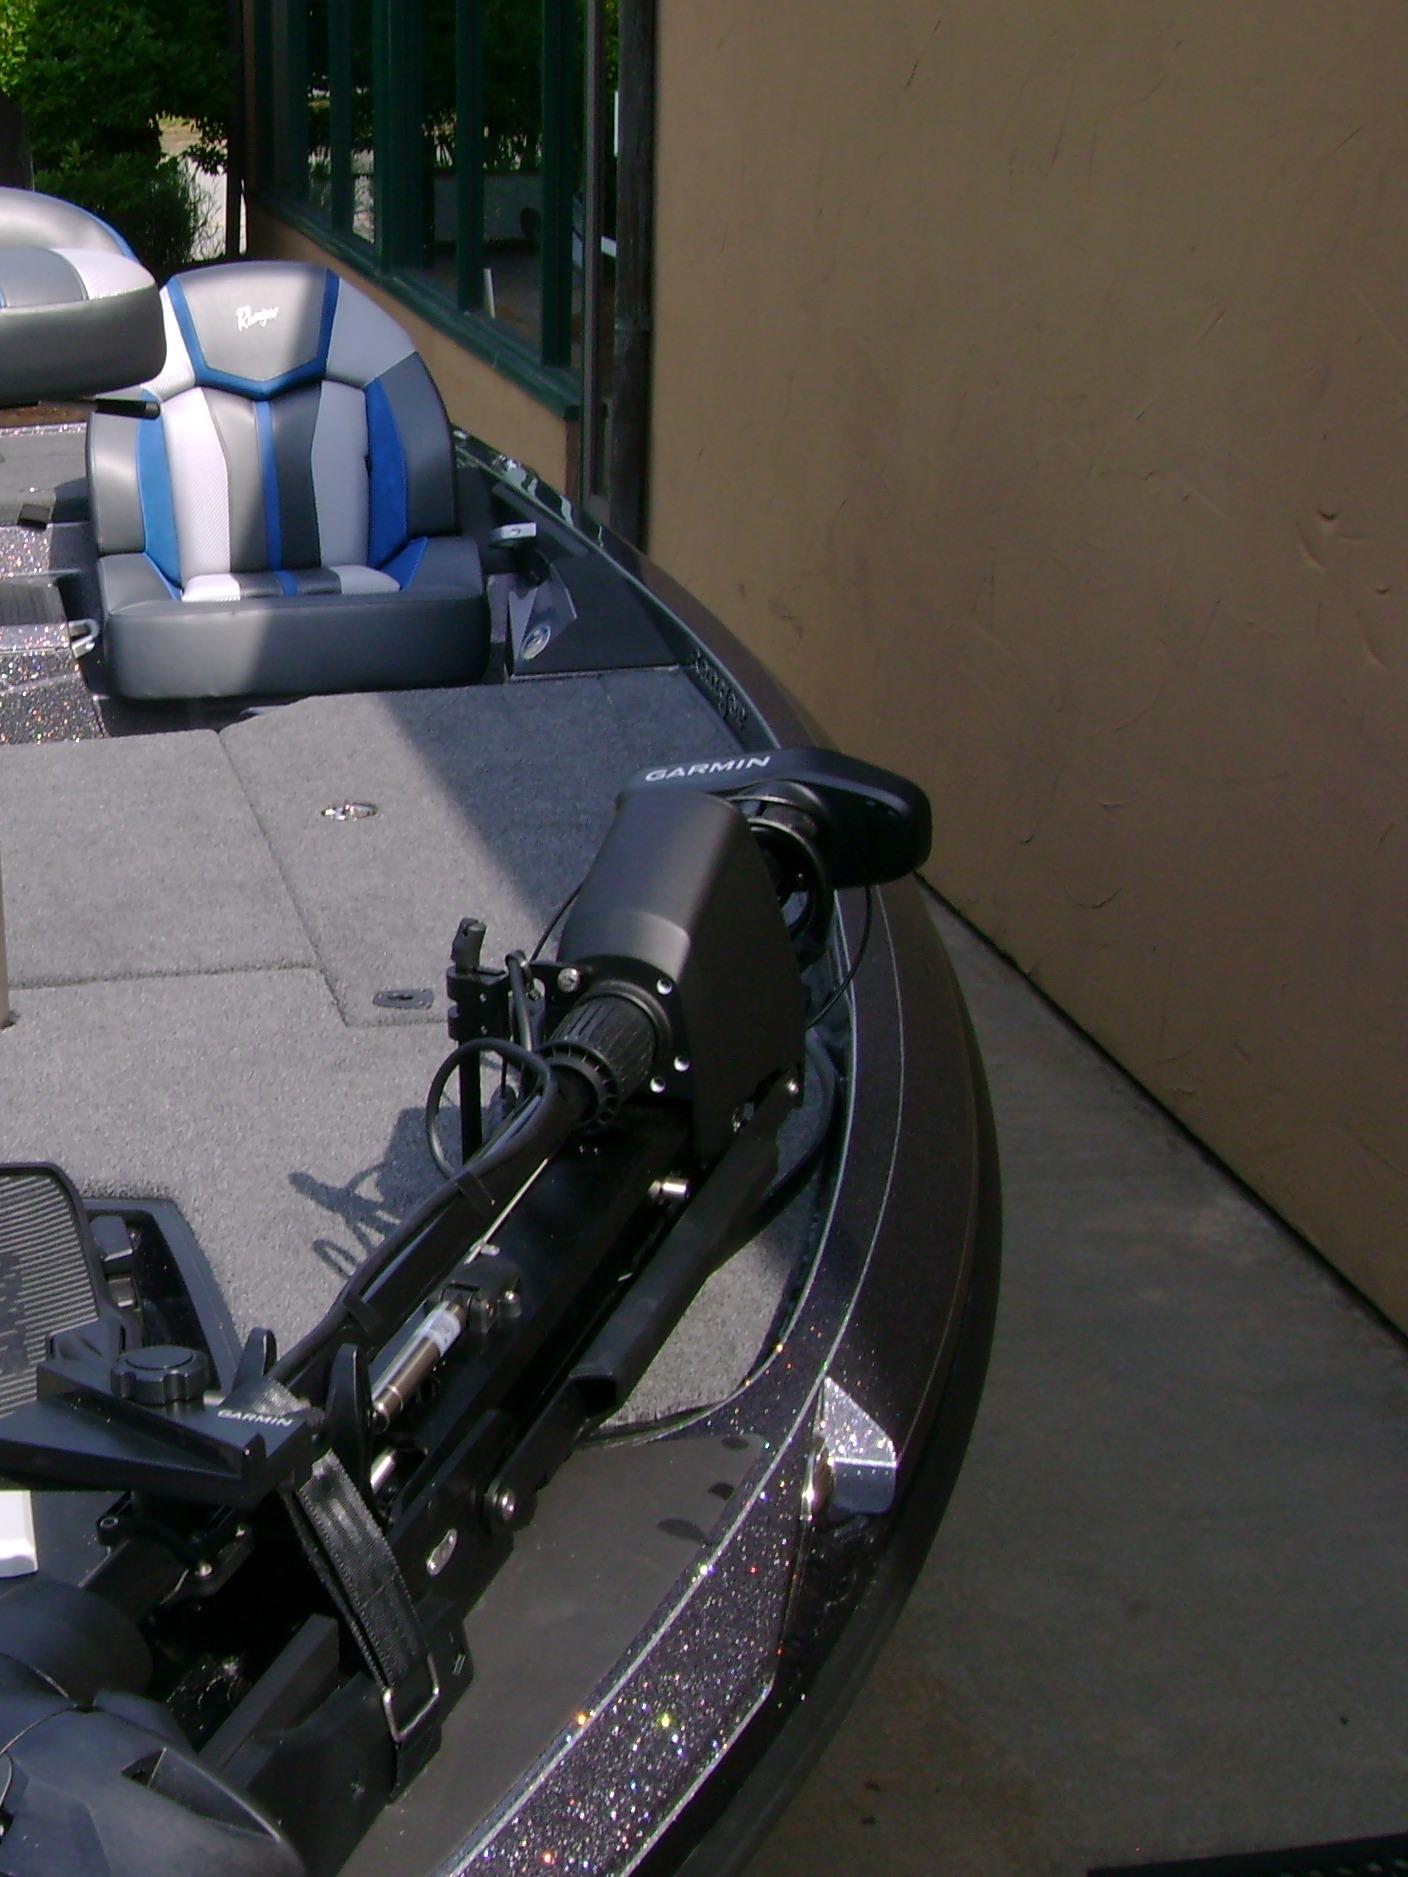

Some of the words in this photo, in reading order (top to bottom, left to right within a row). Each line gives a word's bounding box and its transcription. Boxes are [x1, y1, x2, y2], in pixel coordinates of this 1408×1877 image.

[236, 305, 279, 331] Ranger
[645, 756, 770, 782] GARMIN
[218, 1409, 293, 1427] GARMIN
